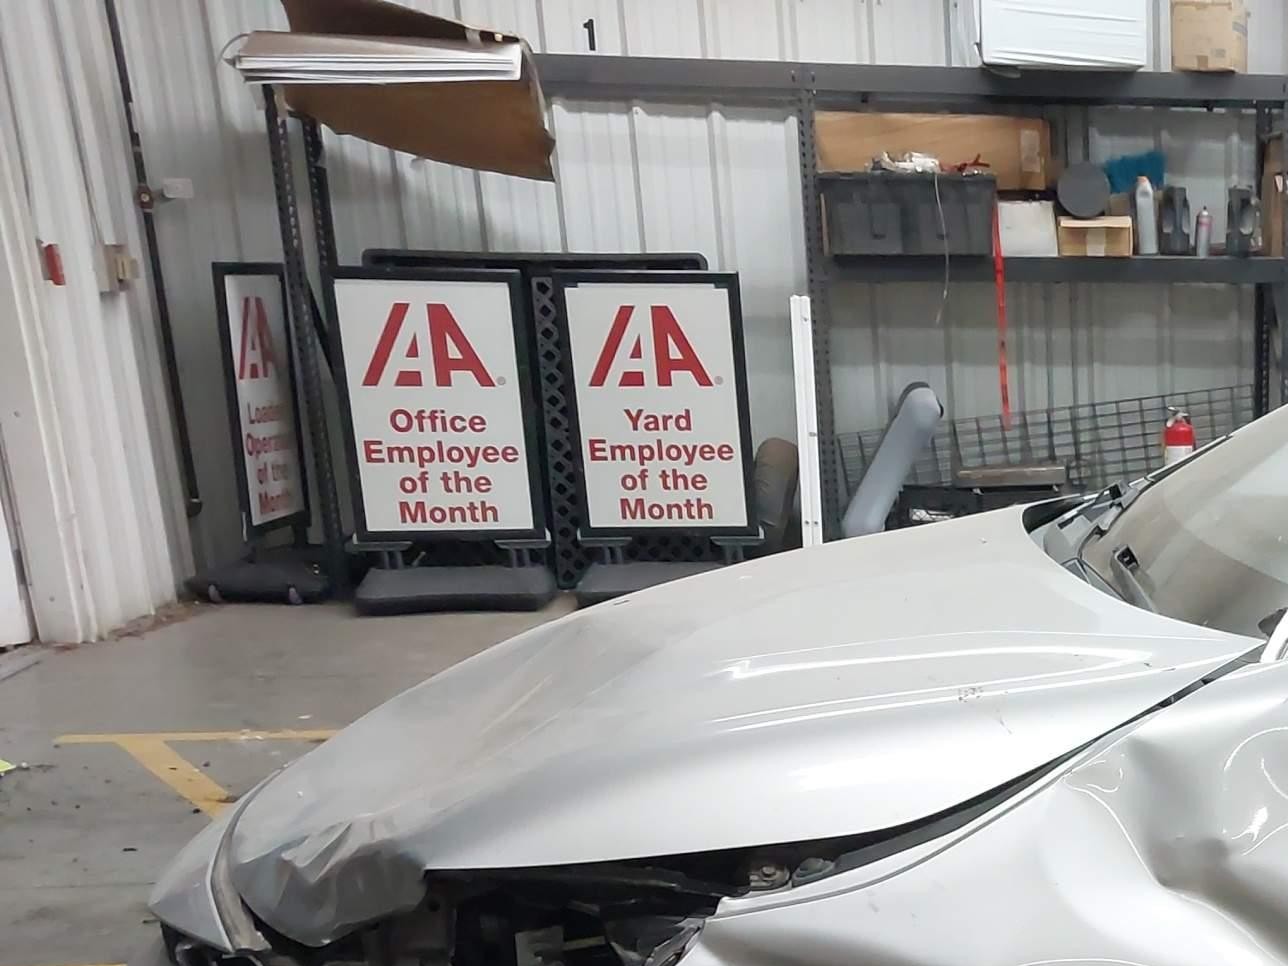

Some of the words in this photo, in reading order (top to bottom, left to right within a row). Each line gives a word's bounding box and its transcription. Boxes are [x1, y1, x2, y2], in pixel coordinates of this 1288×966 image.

[584, 19, 595, 50] 1
[389, 408, 487, 434] Office
[626, 410, 694, 433] Yard
[363, 439, 518, 471] Employee
[588, 438, 735, 466] Employee
[400, 469, 430, 494] of
[442, 473, 492, 493] the
[622, 468, 650, 490] of
[660, 470, 707, 492] the
[400, 500, 499, 524] Month
[620, 497, 713, 519] Month
